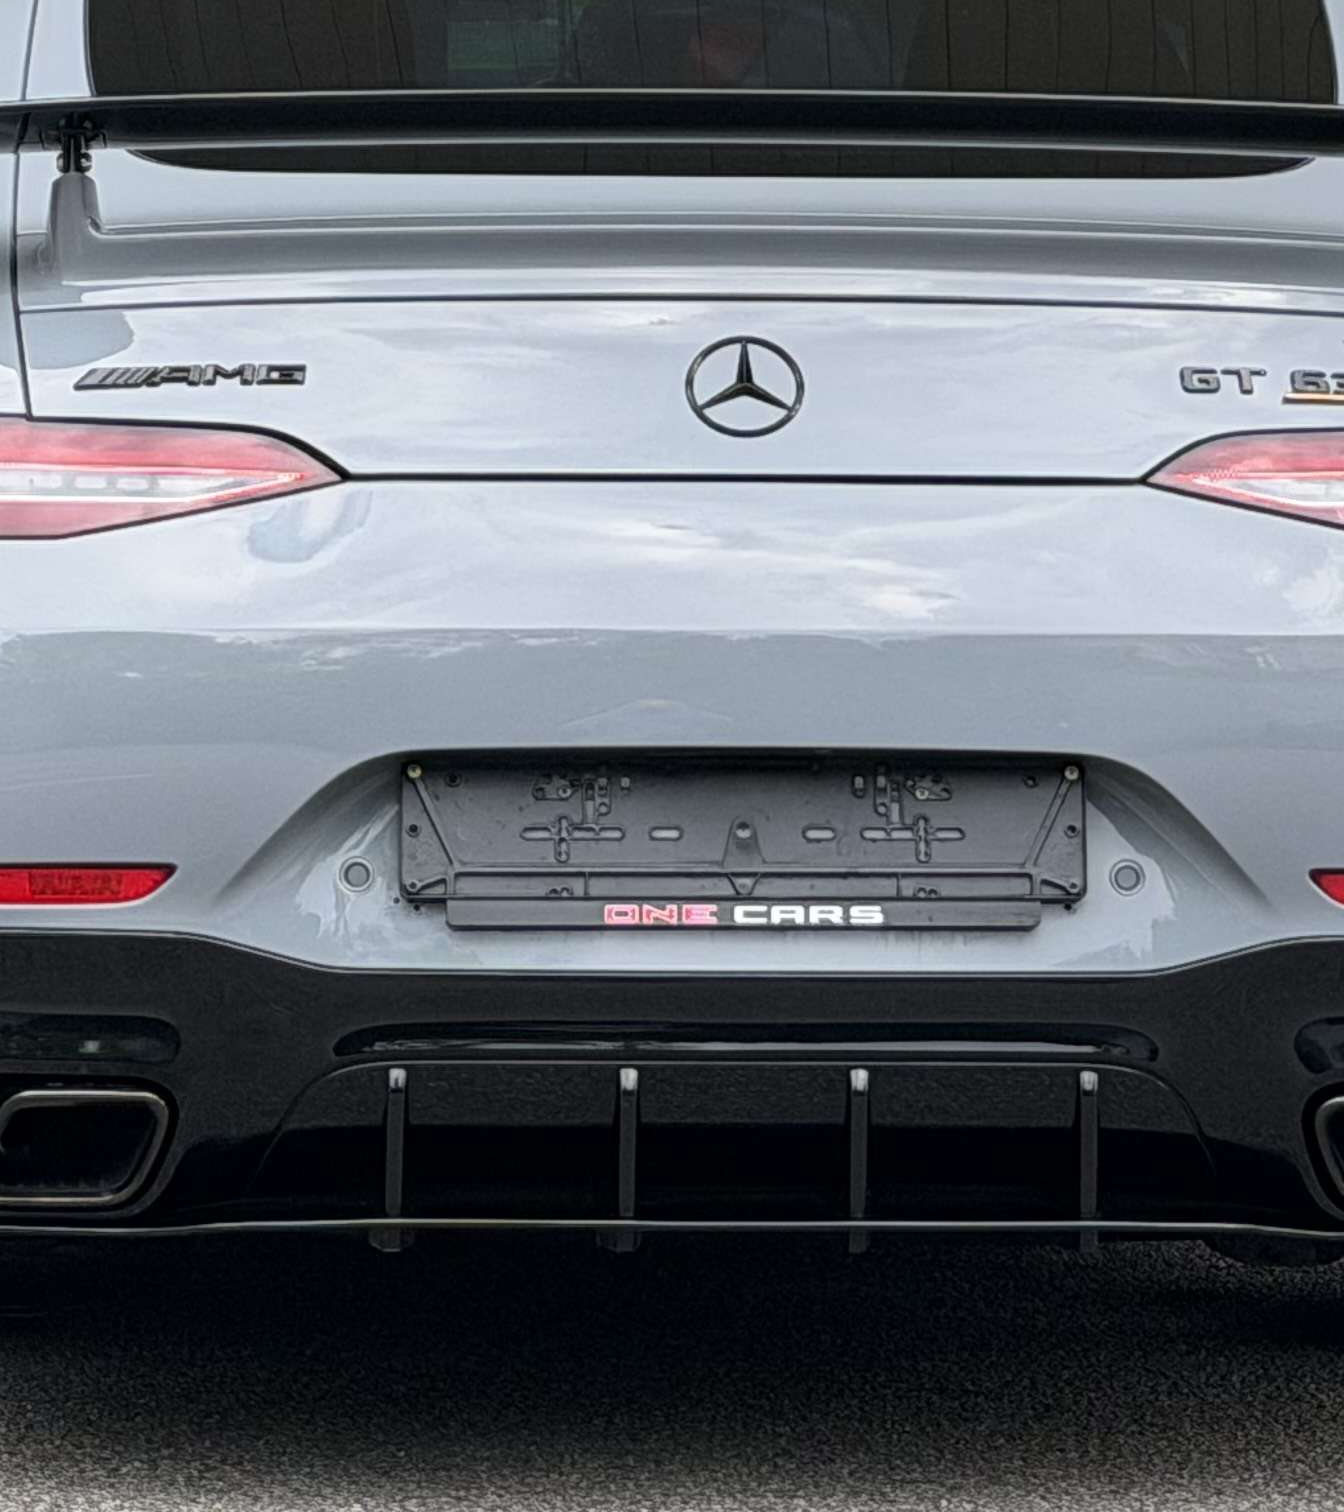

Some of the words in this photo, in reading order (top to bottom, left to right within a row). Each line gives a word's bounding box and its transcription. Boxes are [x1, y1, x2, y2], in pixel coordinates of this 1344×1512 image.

[140, 363, 307, 389] AMG
[1179, 366, 1267, 395] GT
[604, 904, 719, 925] ONE
[733, 904, 885, 925] CARS
